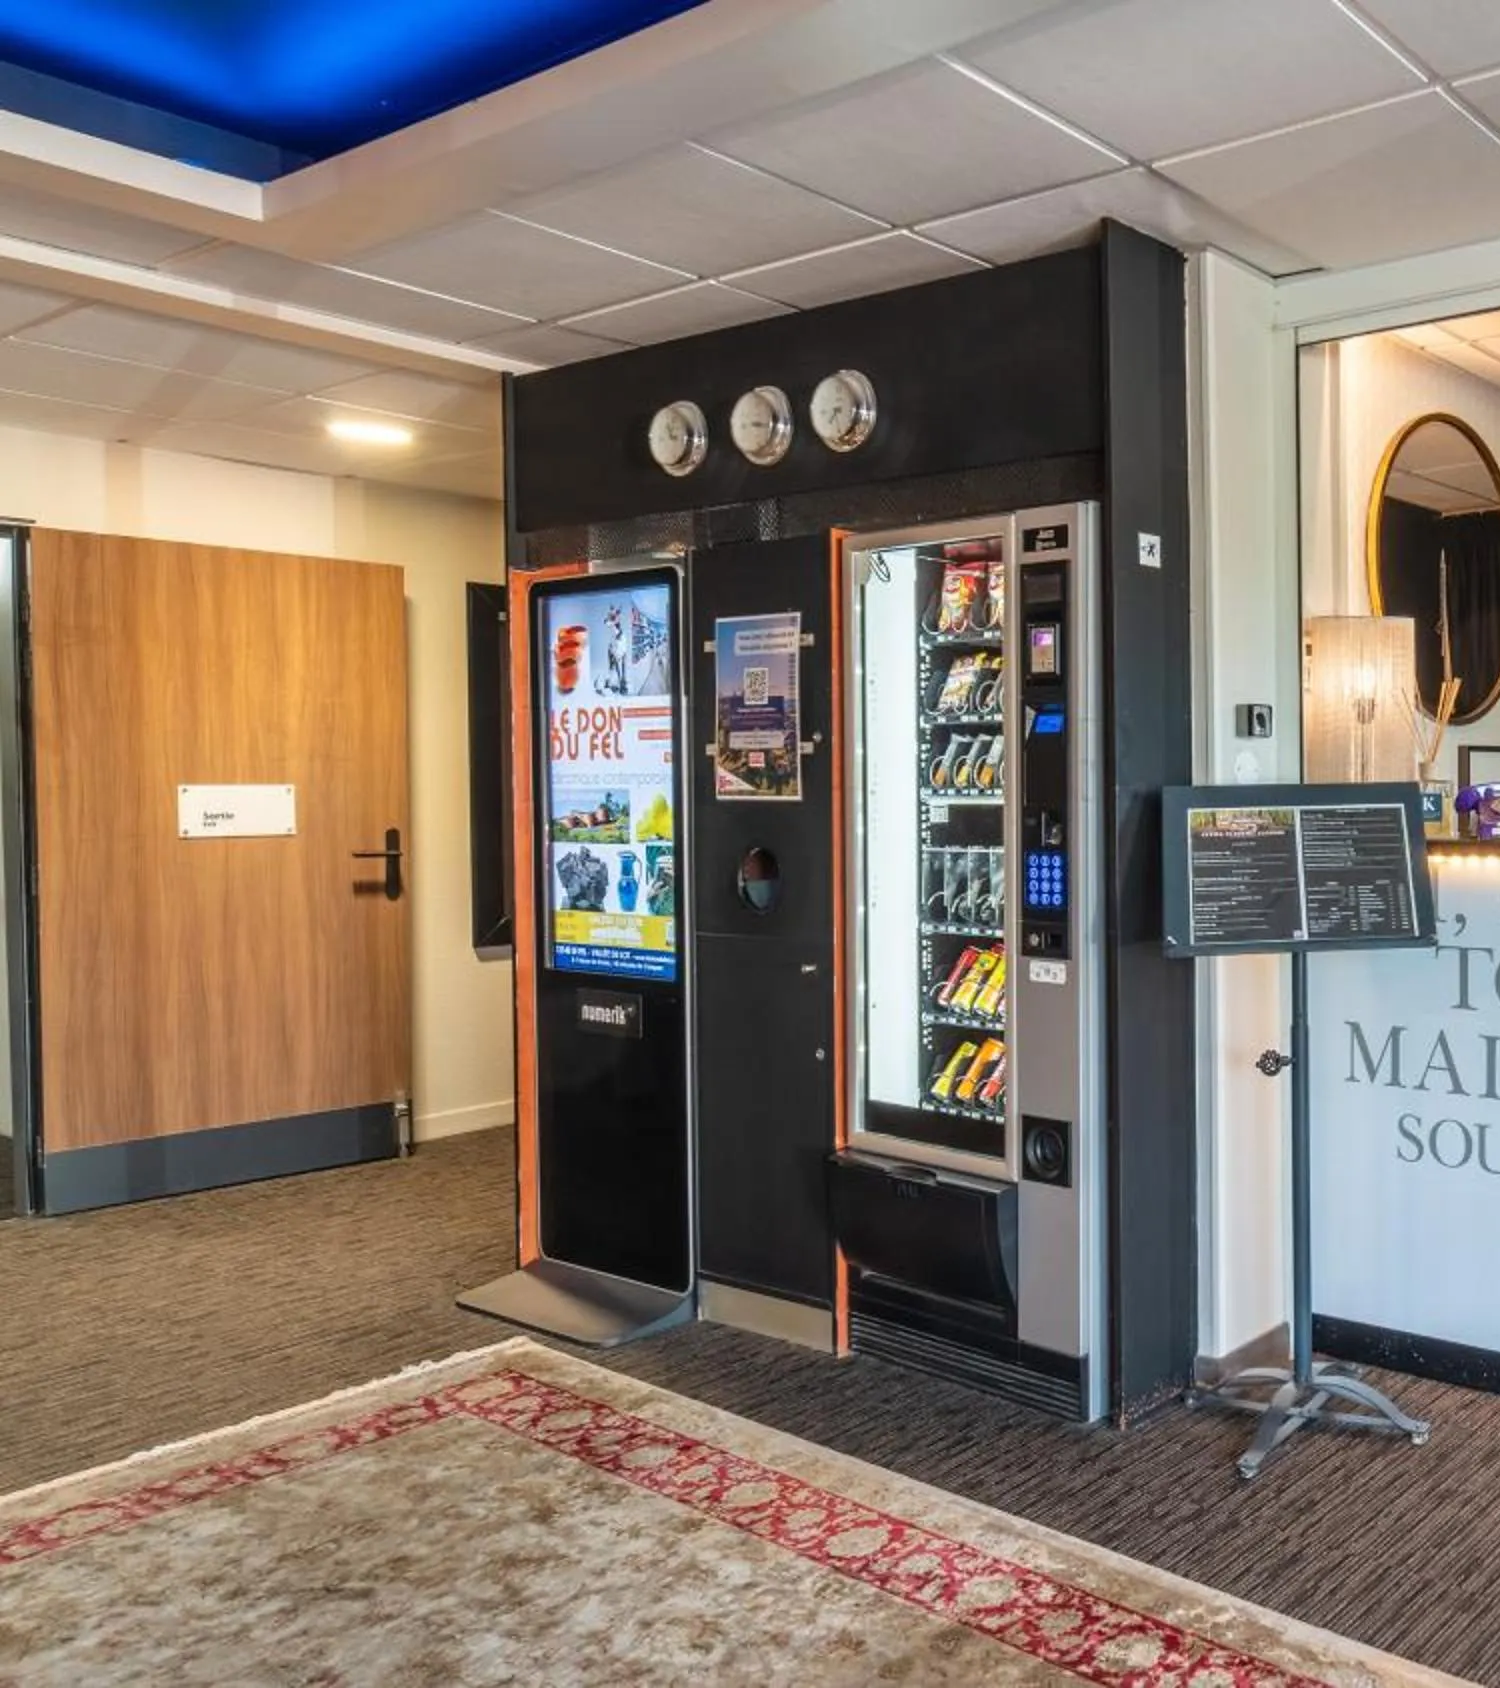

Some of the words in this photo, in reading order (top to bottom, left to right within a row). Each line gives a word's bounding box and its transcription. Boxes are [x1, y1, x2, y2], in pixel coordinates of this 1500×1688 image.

[550, 707, 569, 735] LE
[577, 705, 622, 733] DON
[551, 730, 579, 761] DU
[589, 731, 625, 761] FEL
